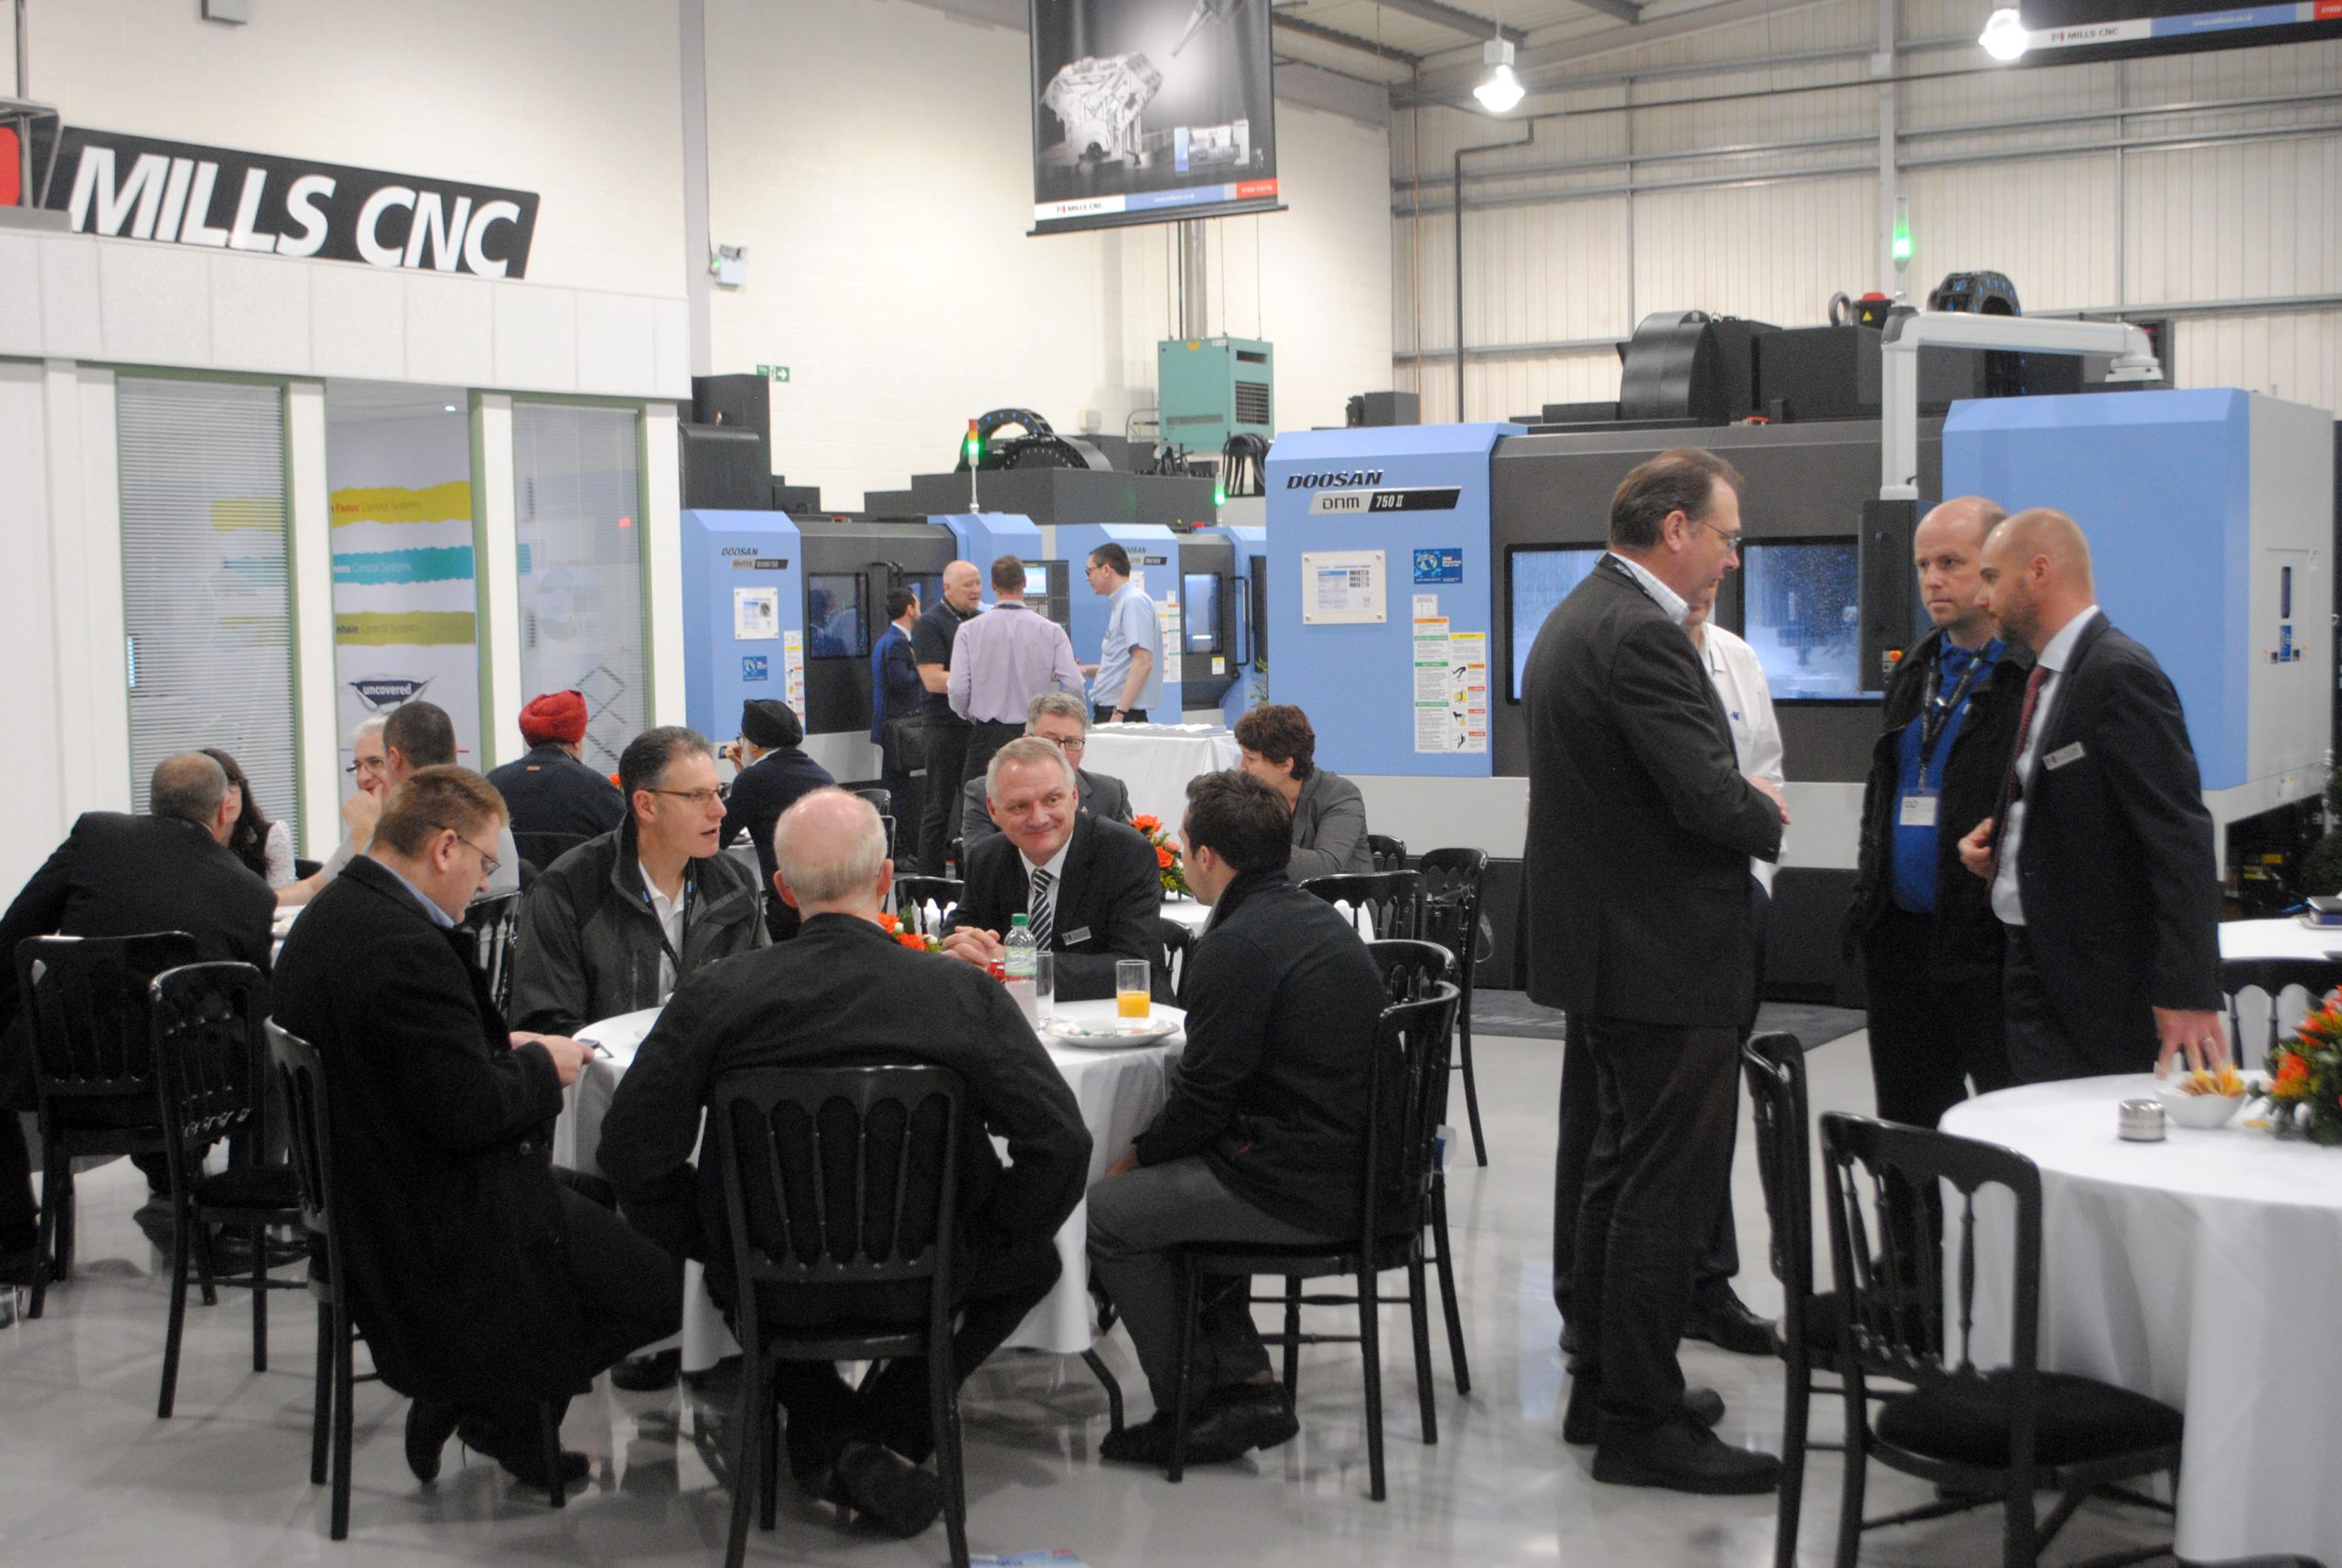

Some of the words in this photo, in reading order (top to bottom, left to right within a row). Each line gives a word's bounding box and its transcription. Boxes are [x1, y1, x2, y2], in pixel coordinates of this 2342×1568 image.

[2068, 29, 2095, 40] MILLS
[2099, 27, 2119, 38] CNC
[69, 145, 337, 257] MILLS
[356, 186, 521, 278] CNC
[1286, 469, 1384, 489] DOOSAN
[336, 503, 360, 512] Fanuc
[1376, 495, 1395, 509] 750
[722, 547, 758, 556] DOOSAN
[363, 683, 412, 695] uncovered
